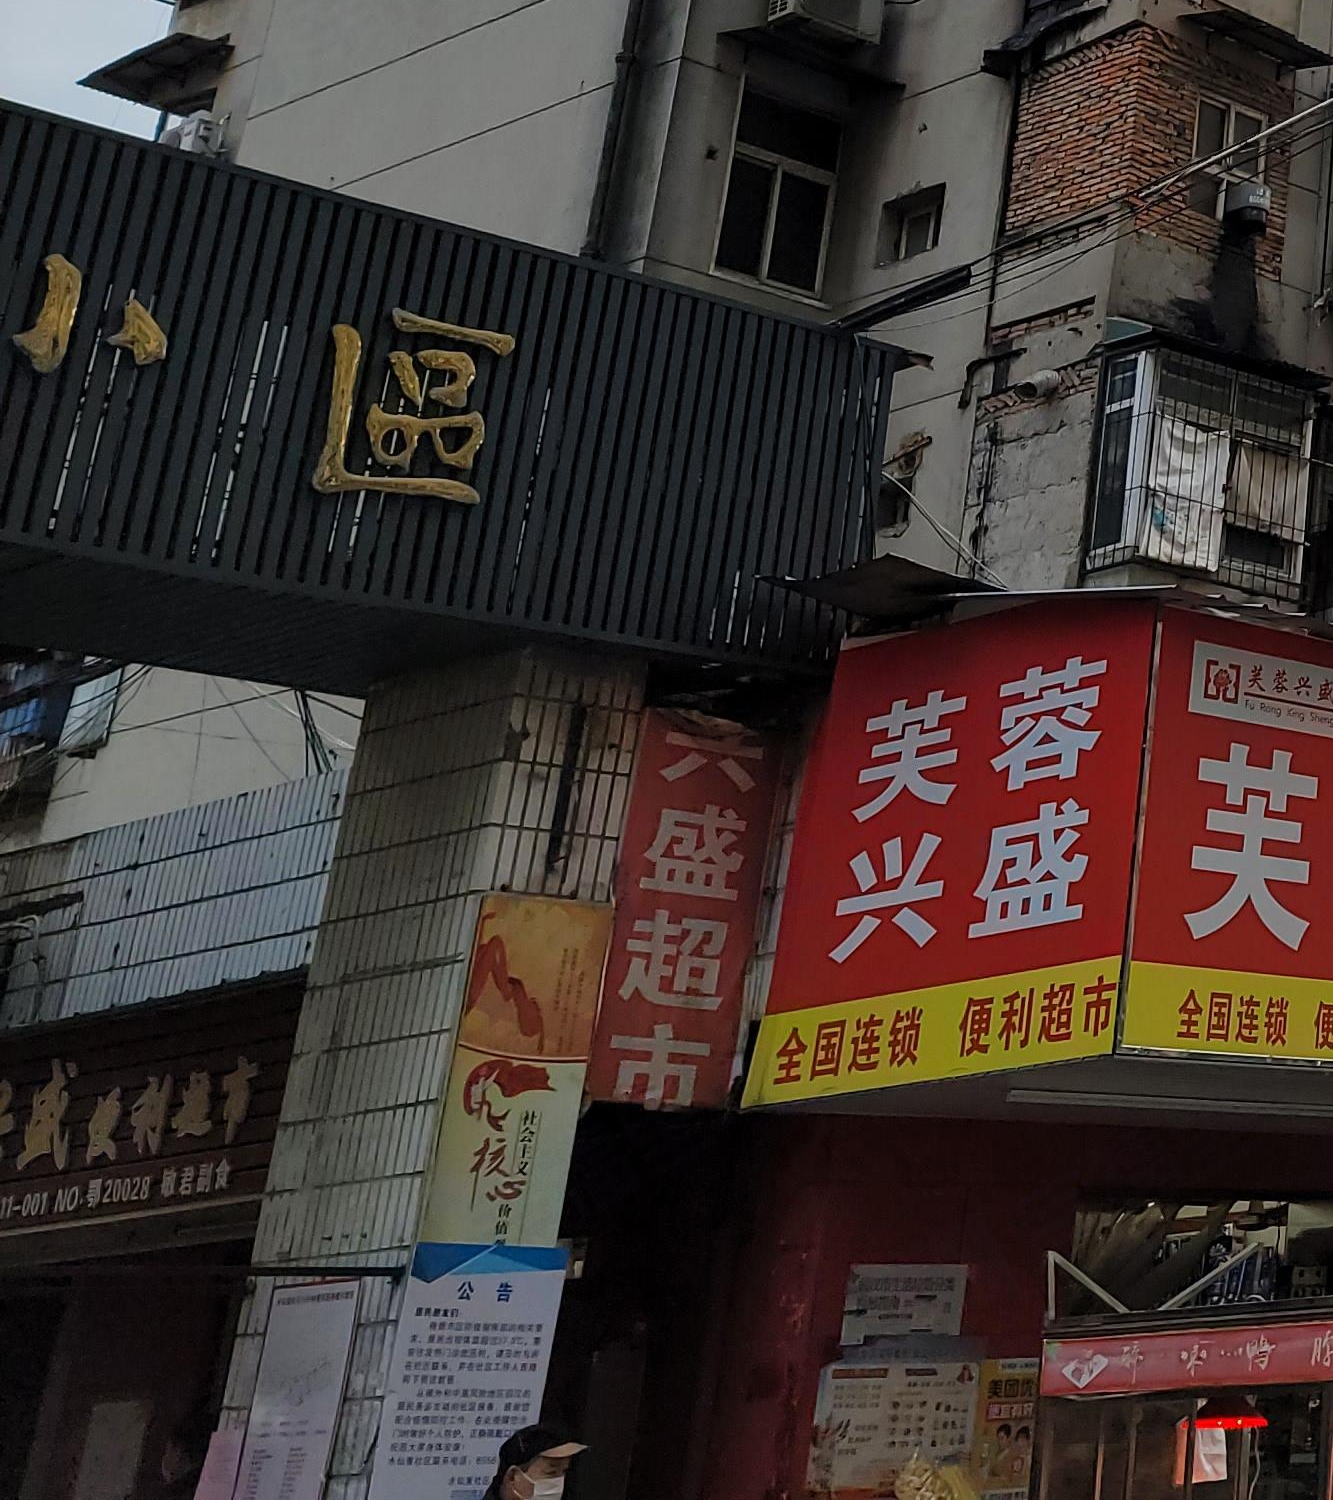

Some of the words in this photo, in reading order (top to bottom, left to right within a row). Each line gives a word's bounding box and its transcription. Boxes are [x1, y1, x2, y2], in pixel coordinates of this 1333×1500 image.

[852, 655, 1107, 823] 芙蓉
[828, 797, 1089, 963] 兴盛
[773, 1006, 923, 1085] 全国连锁
[959, 975, 1119, 1057] 便利超市
[1176, 988, 1290, 1046] 全国连锁
[457, 1280, 513, 1303] 公告
